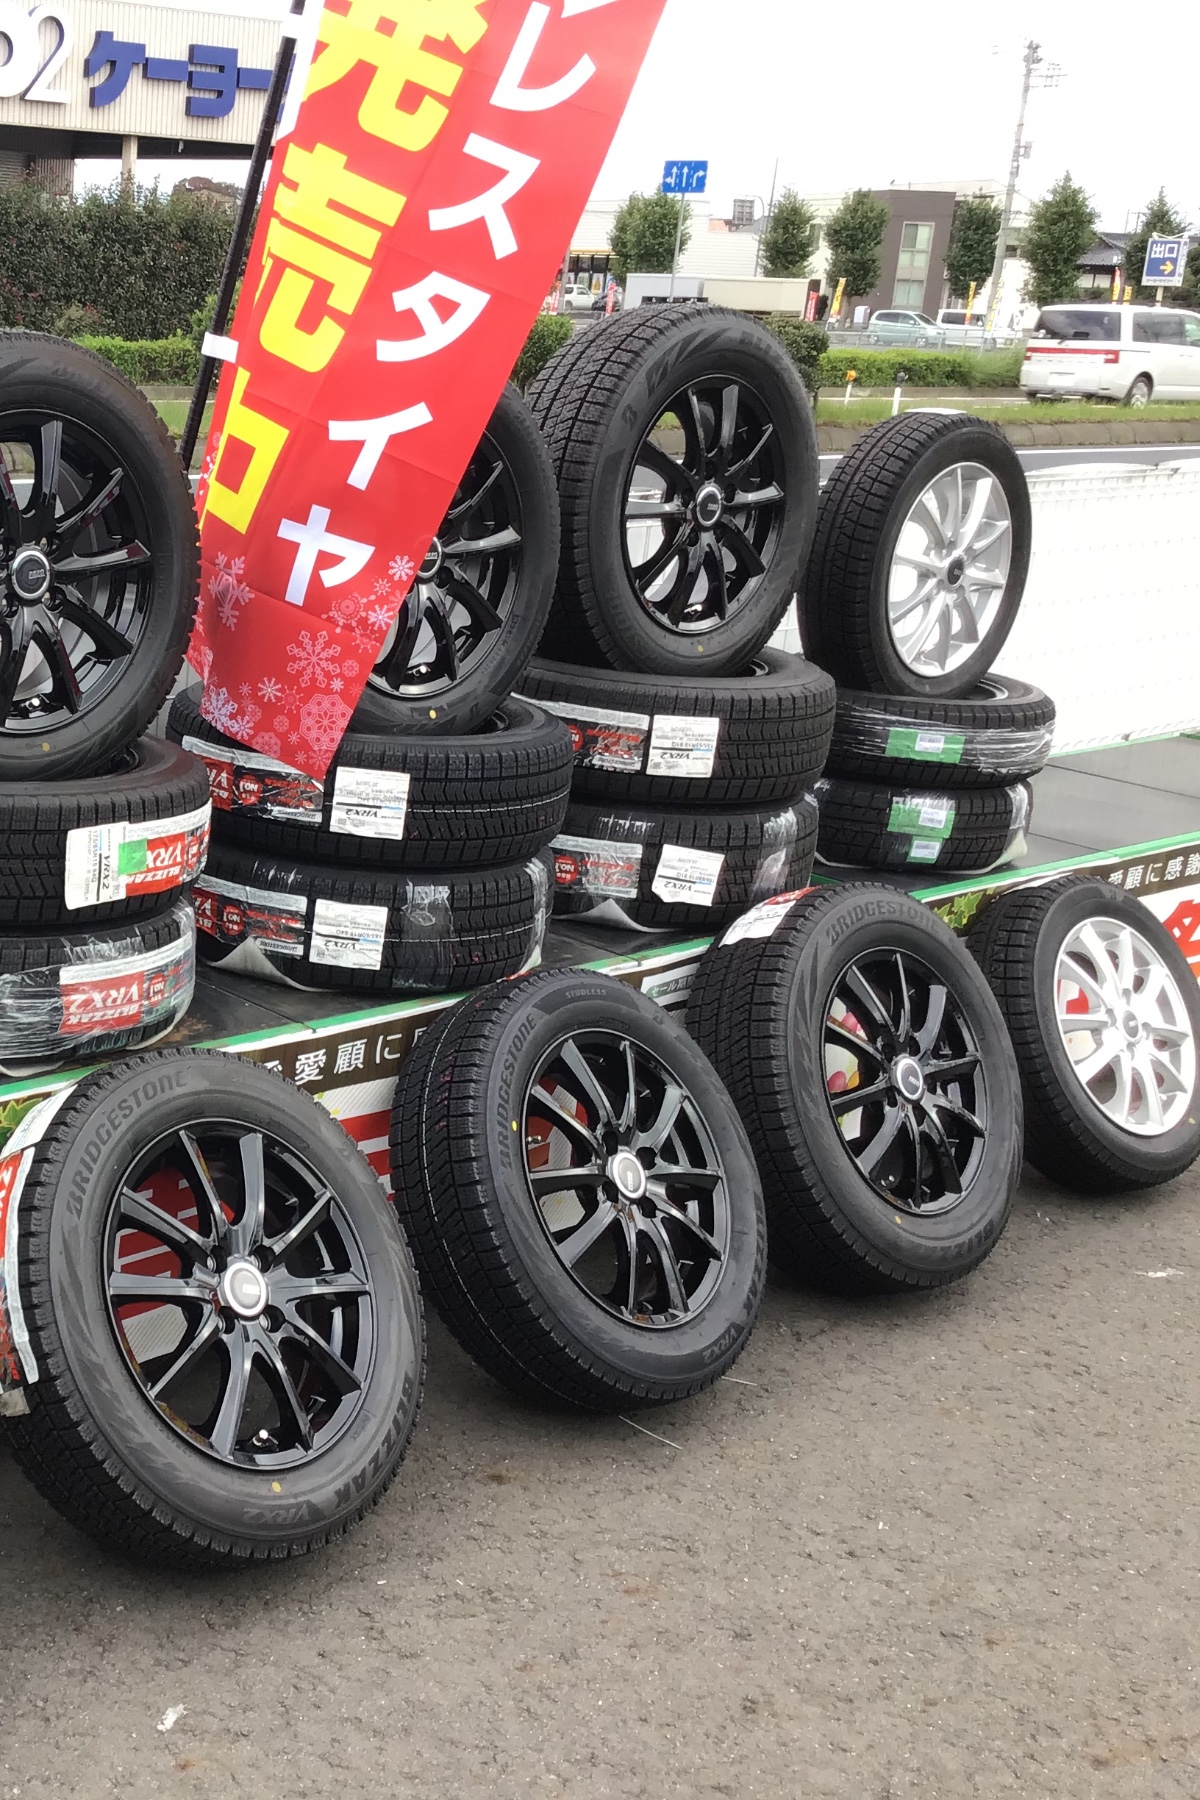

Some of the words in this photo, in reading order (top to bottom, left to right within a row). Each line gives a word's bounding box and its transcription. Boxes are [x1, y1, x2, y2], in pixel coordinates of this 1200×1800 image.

[83, 30, 296, 123] ケーヨー
[1150, 243, 1178, 258] 出口
[277, 0, 618, 607] レスタイヤ
[660, 752, 691, 760] VRX2
[345, 808, 379, 818] VRX2
[102, 855, 111, 890] VRX2
[663, 881, 693, 892] VRX2
[825, 899, 943, 947] BRIDGESTONE
[324, 940, 356, 950] VRX2
[69, 980, 140, 1013] VRX2
[565, 988, 608, 999] STUDLESS
[65, 1004, 140, 1025] BLIZZAK
[496, 1012, 538, 1170] BRIDGESTONE
[65, 1069, 189, 1221] BRIDGESTONE
[702, 1326, 738, 1364] VRX2
[241, 1503, 312, 1530] VRX2
